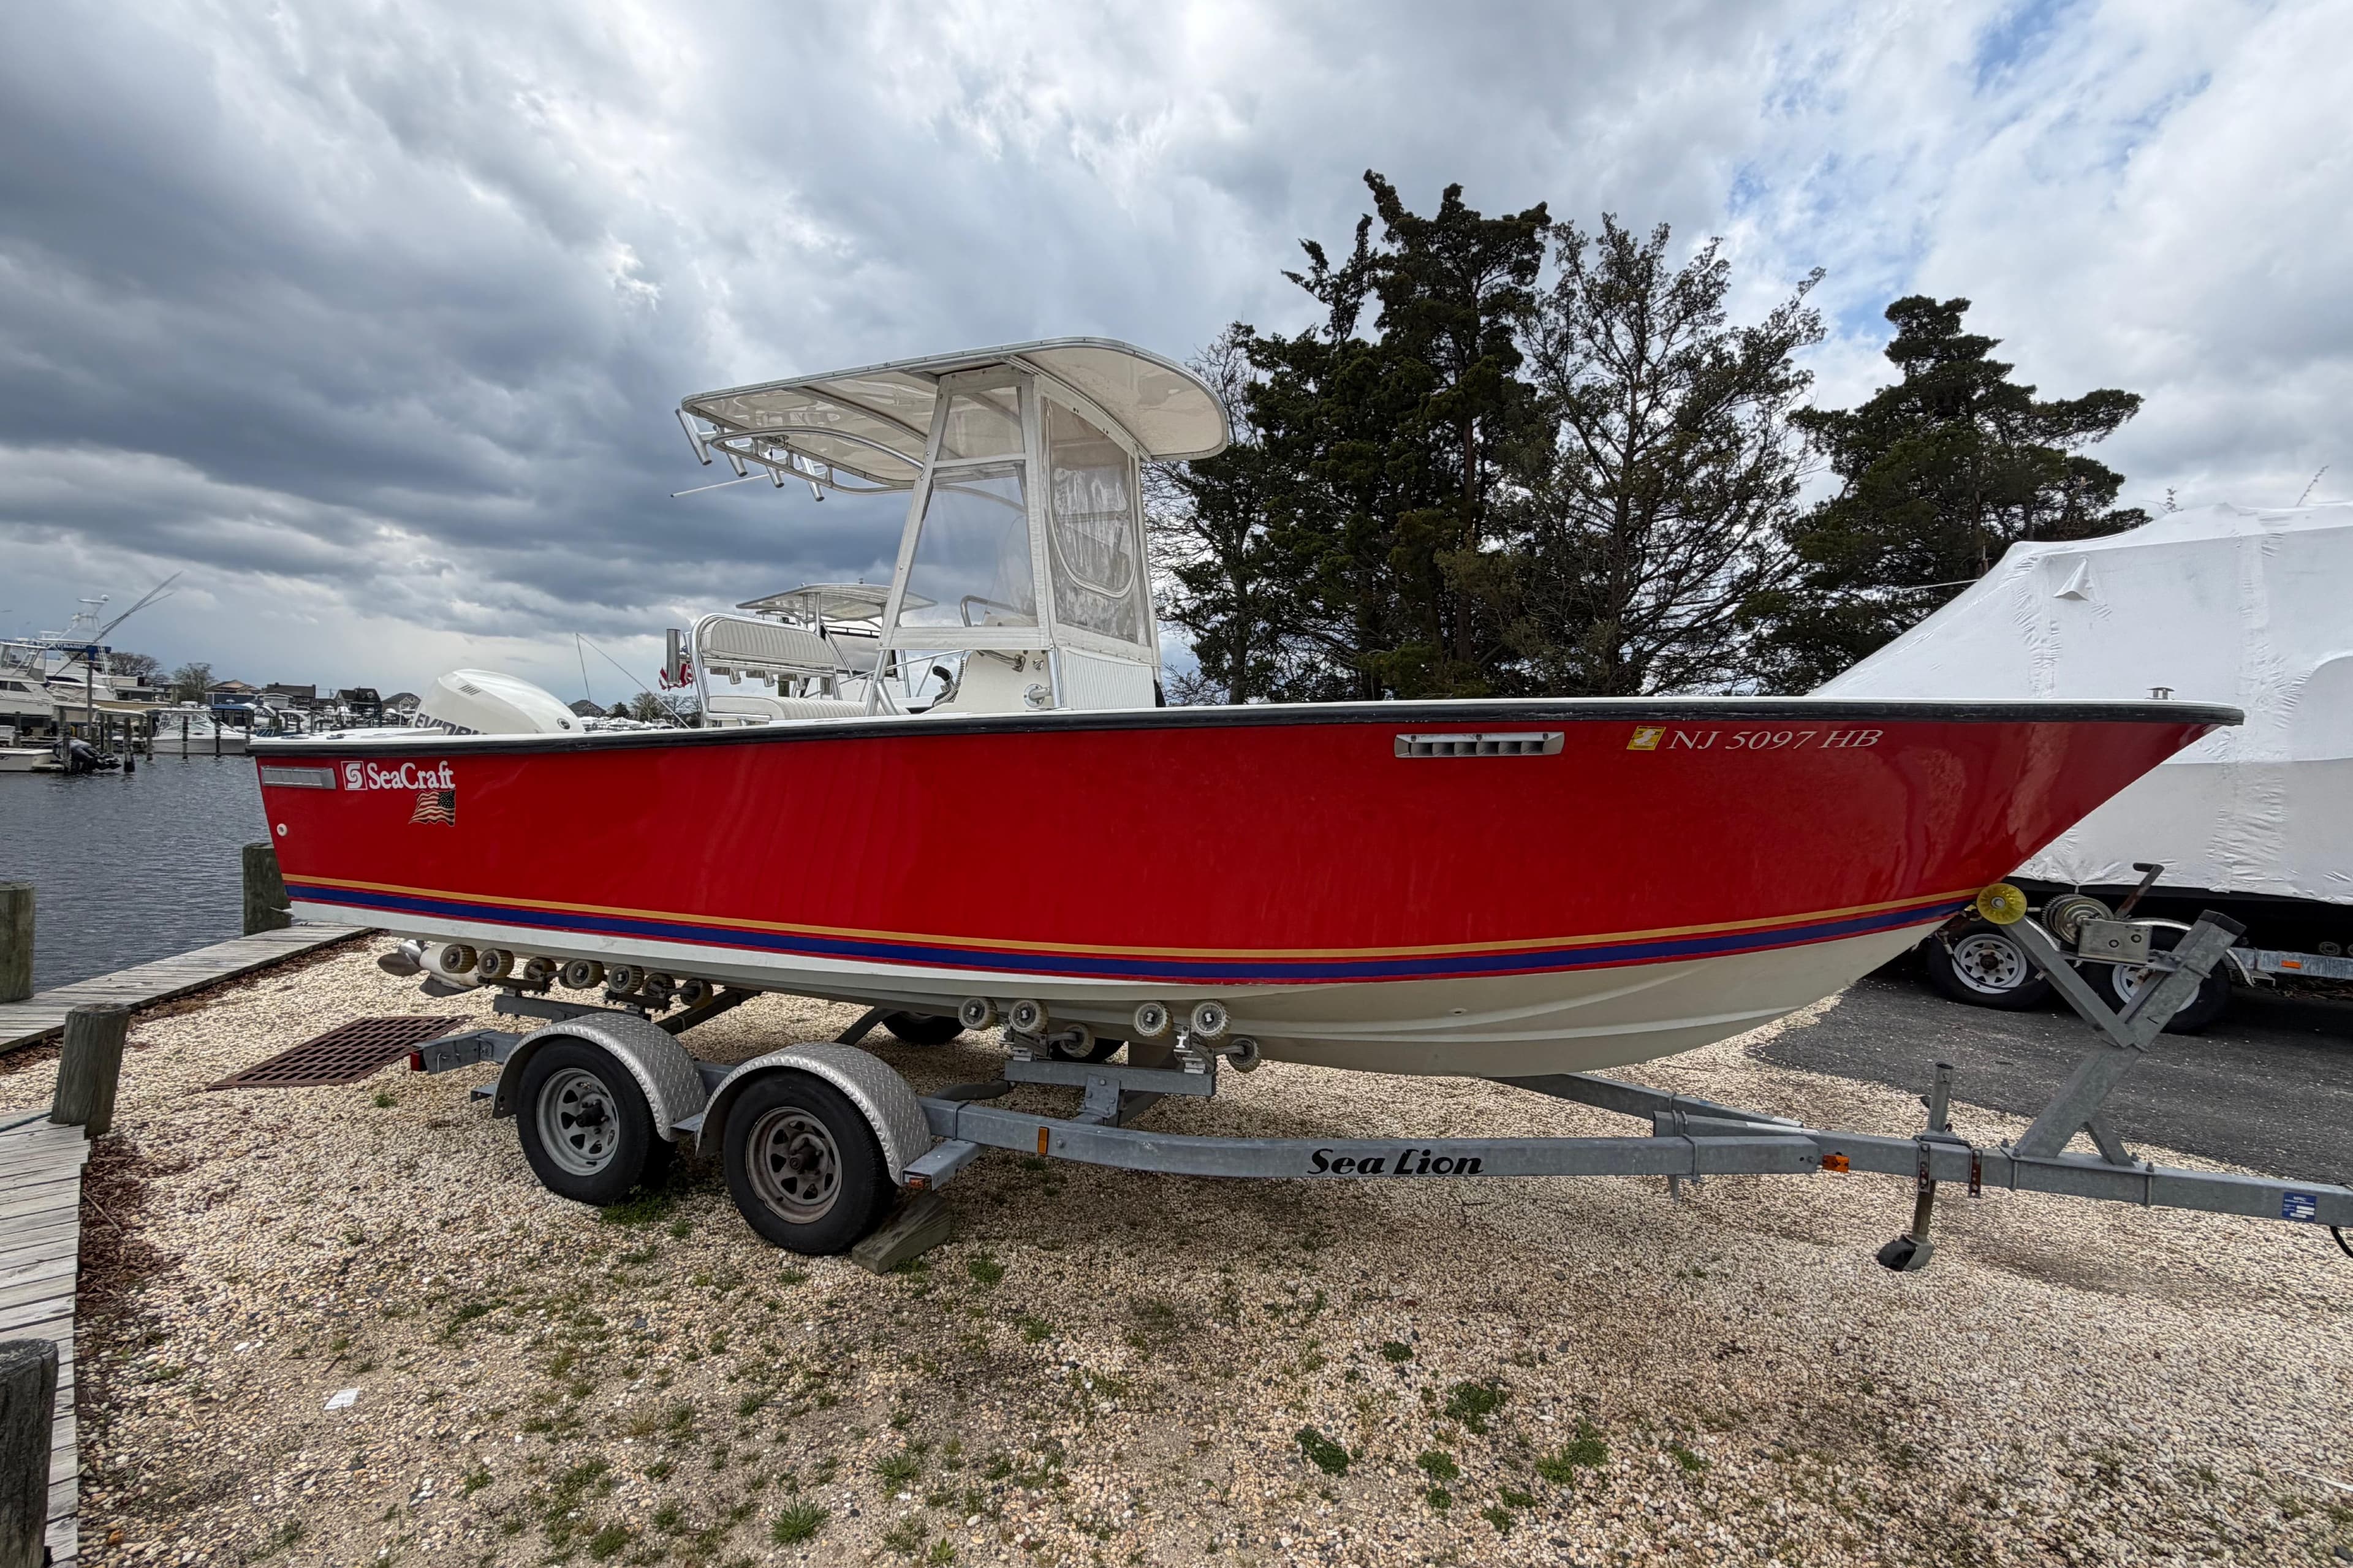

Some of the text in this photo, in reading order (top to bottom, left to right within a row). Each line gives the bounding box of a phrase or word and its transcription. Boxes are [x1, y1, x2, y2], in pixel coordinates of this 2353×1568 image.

[1666, 730, 1884, 749] NJ 5097 HB
[368, 760, 455, 789] SeaCraft
[1307, 1148, 1483, 1175] Sea Lion
